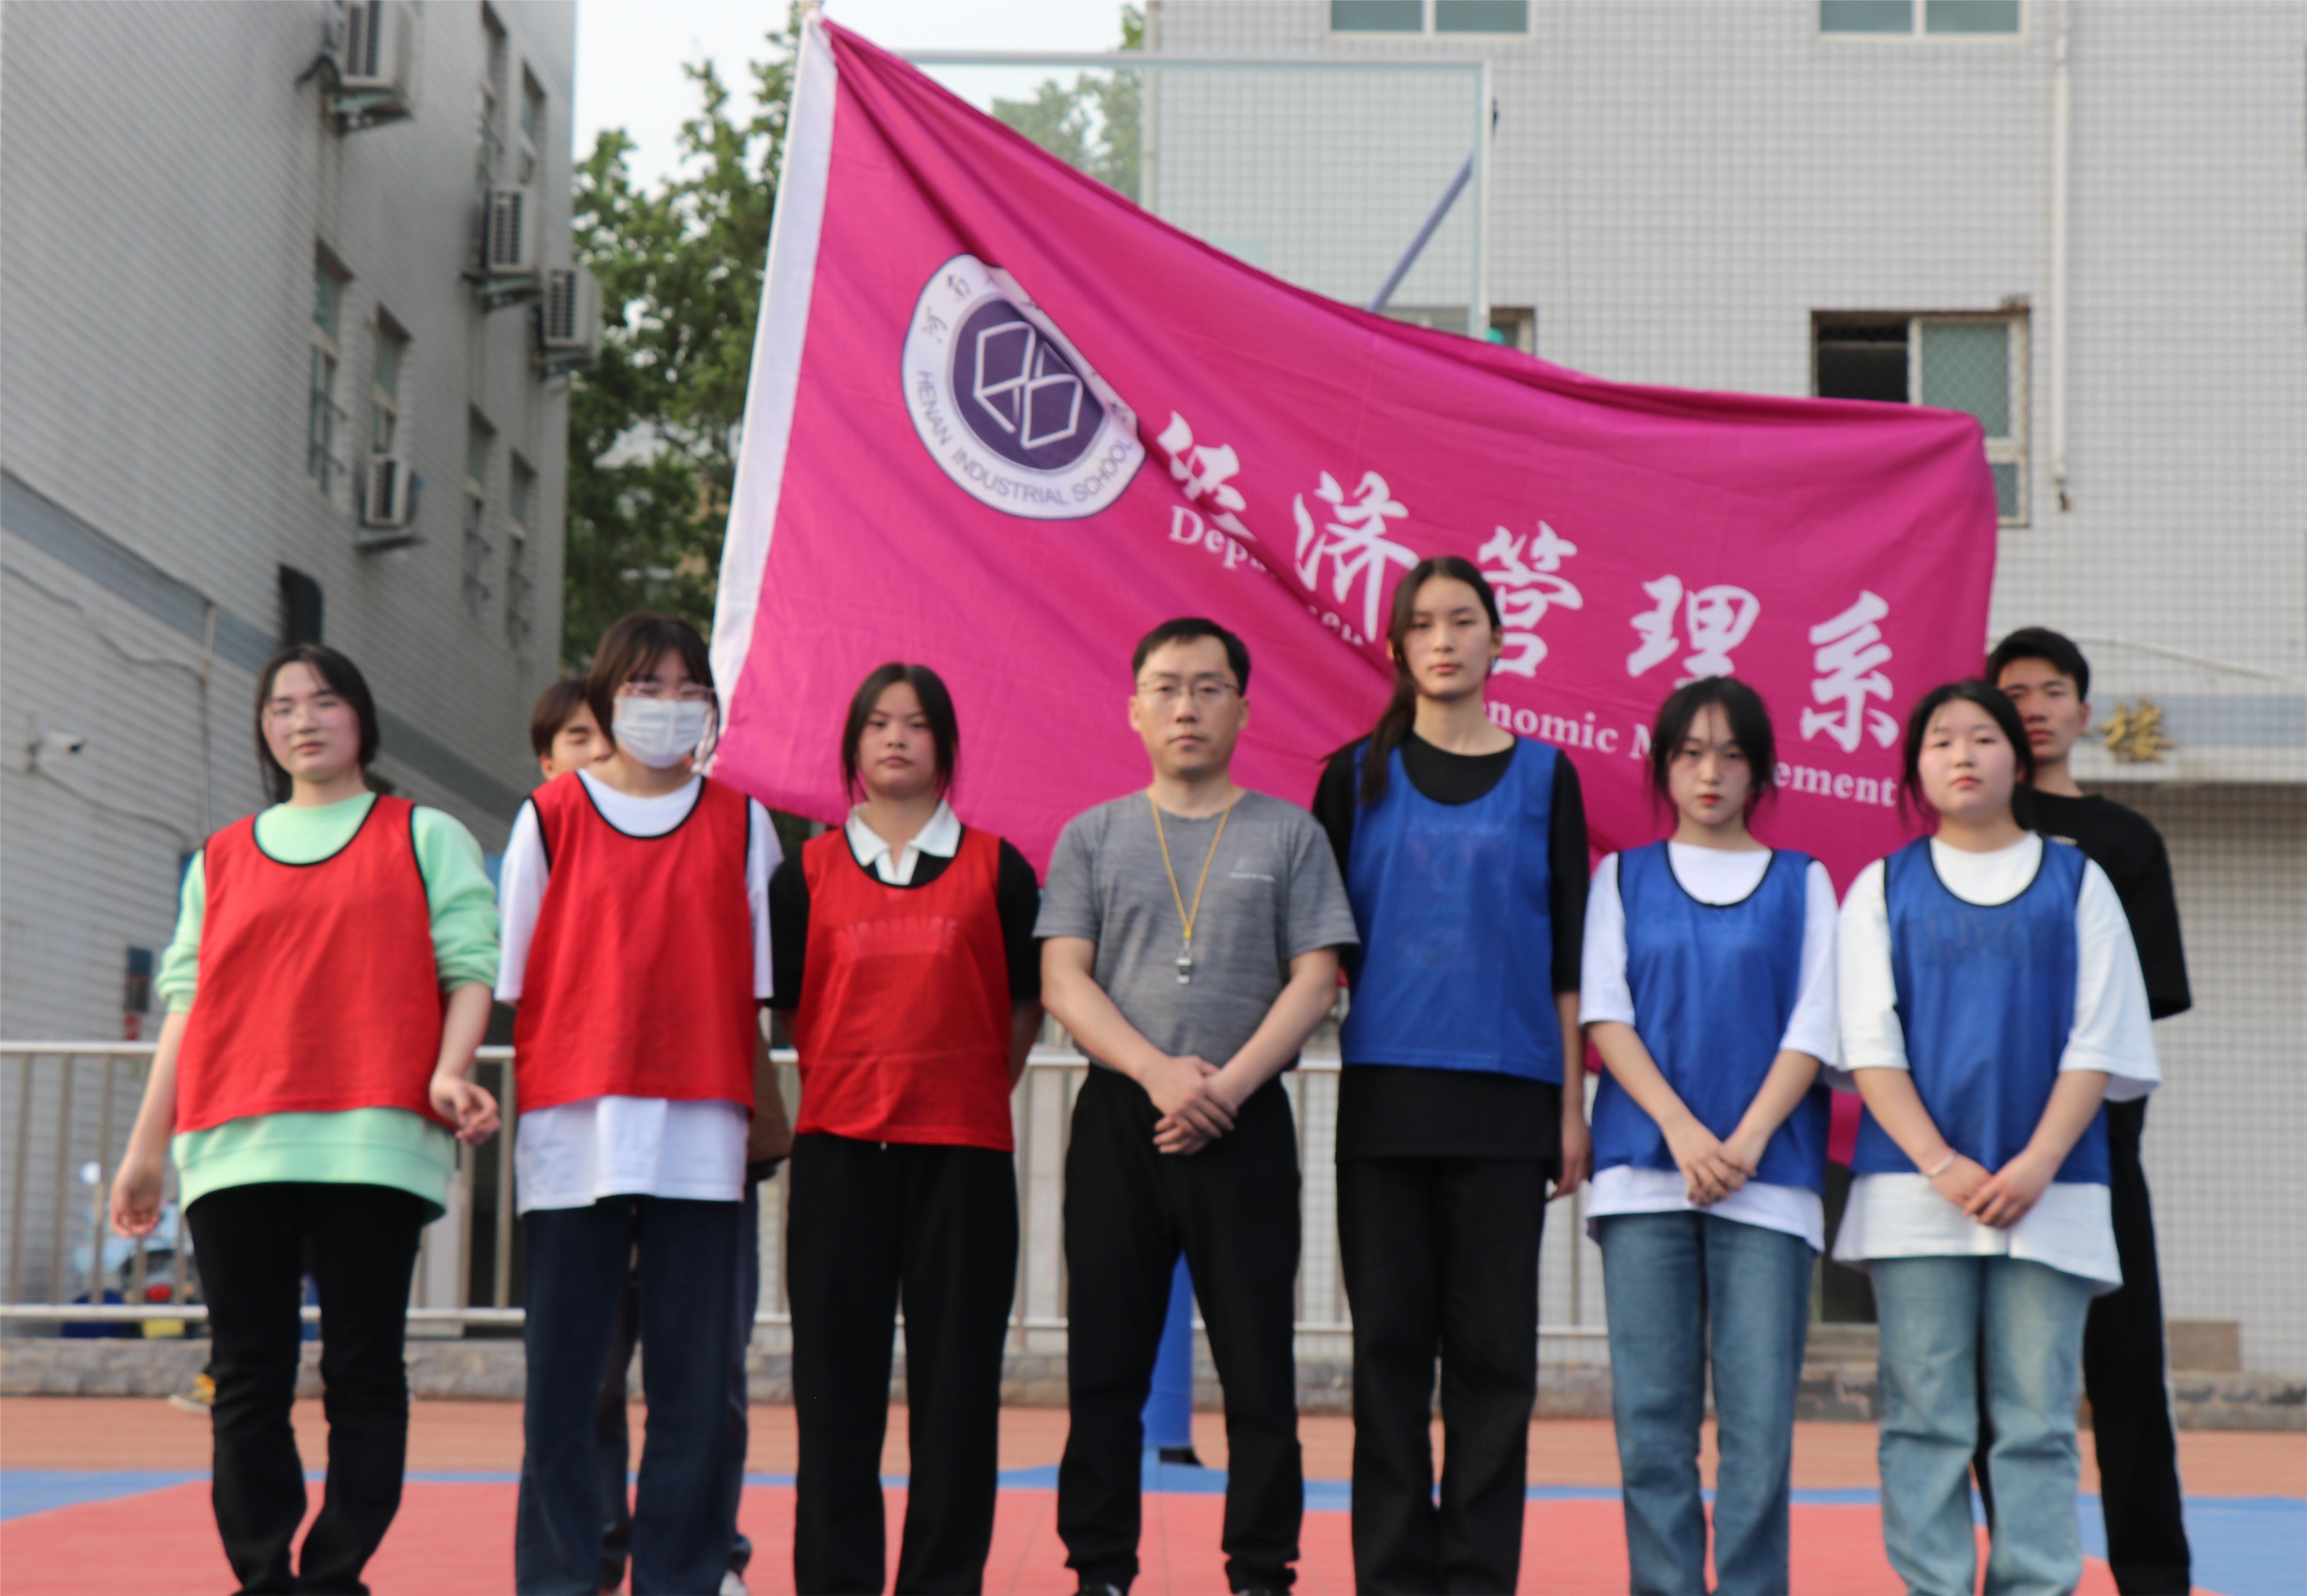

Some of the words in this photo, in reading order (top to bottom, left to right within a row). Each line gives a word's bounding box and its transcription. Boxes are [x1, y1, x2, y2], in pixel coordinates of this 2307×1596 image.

[917, 370, 953, 445] HENAN
[951, 446, 1069, 506] INDUSTRIAL
[1071, 437, 1134, 501] SCHOOL
[1484, 700, 1619, 754] nomic
